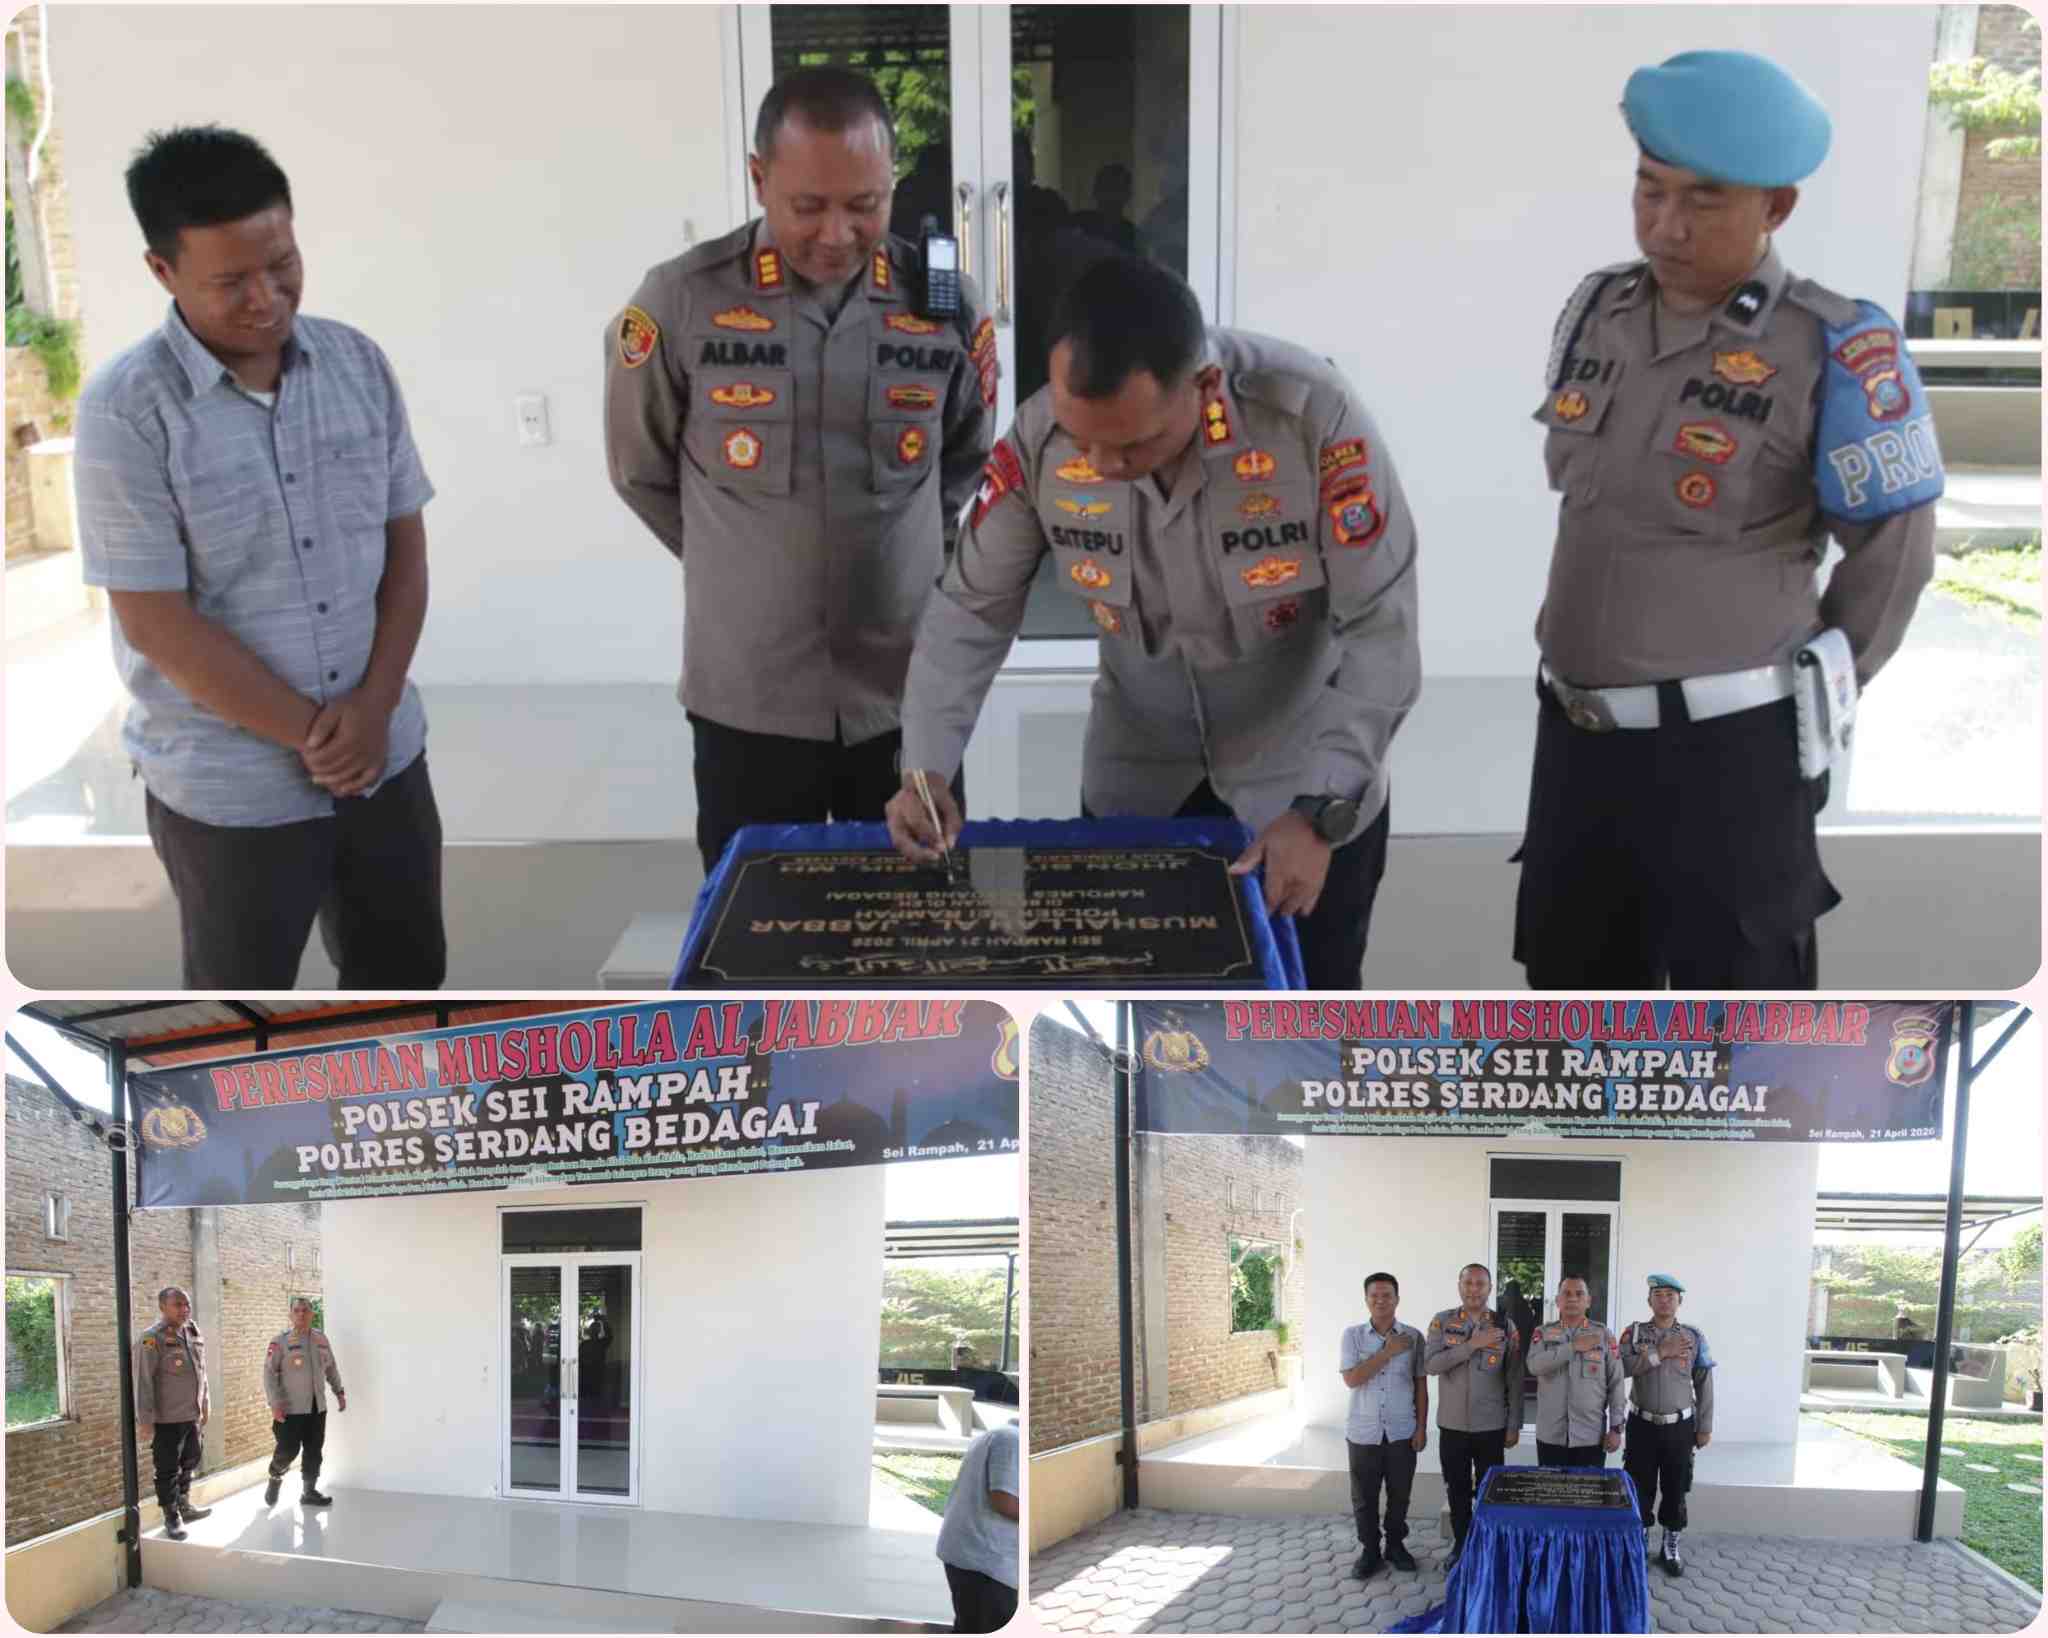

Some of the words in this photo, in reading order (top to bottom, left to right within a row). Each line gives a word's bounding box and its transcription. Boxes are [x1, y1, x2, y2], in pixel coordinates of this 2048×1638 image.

[701, 341, 787, 367] ALBAR
[877, 343, 954, 371] POLRI
[1680, 378, 1773, 425] POLRI
[1051, 523, 1124, 556] SITEPU
[1221, 520, 1309, 555] POLRI
[750, 919, 900, 933] JABBAR
[936, 917, 972, 932] AL
[1223, 1000, 1442, 1041] PERESMIAN
[1450, 1000, 1662, 1044] MUSHOLLA
[1662, 1001, 1714, 1044] AL
[1718, 1001, 1870, 1046] JABBAR
[211, 1042, 428, 1112] PERESMIAN
[435, 1012, 678, 1085] MUSHOLLA
[683, 1004, 750, 1062] AL
[754, 1000, 967, 1055] JABBAR
[1352, 1047, 1484, 1077] POLSEK
[1493, 1047, 1549, 1077] SEI
[1560, 1048, 1718, 1078] RAMPAH
[341, 1091, 478, 1136] POLSEK
[487, 1086, 548, 1121] SEI
[561, 1064, 753, 1116] RAMPAH
[1300, 1081, 1431, 1109] POLRES
[1440, 1081, 1603, 1111] SERDANG
[1613, 1084, 1769, 1113] BEDAGAI
[296, 1137, 426, 1173] POLRES
[435, 1121, 613, 1163] SERDANG
[623, 1100, 822, 1150] BEDAGAI
[882, 1146, 904, 1159] Sei
[908, 1141, 969, 1157] Rampah,
[976, 1138, 995, 1151] 21
[1869, 1128, 1881, 1138] 21
[1884, 1127, 1907, 1140] April
